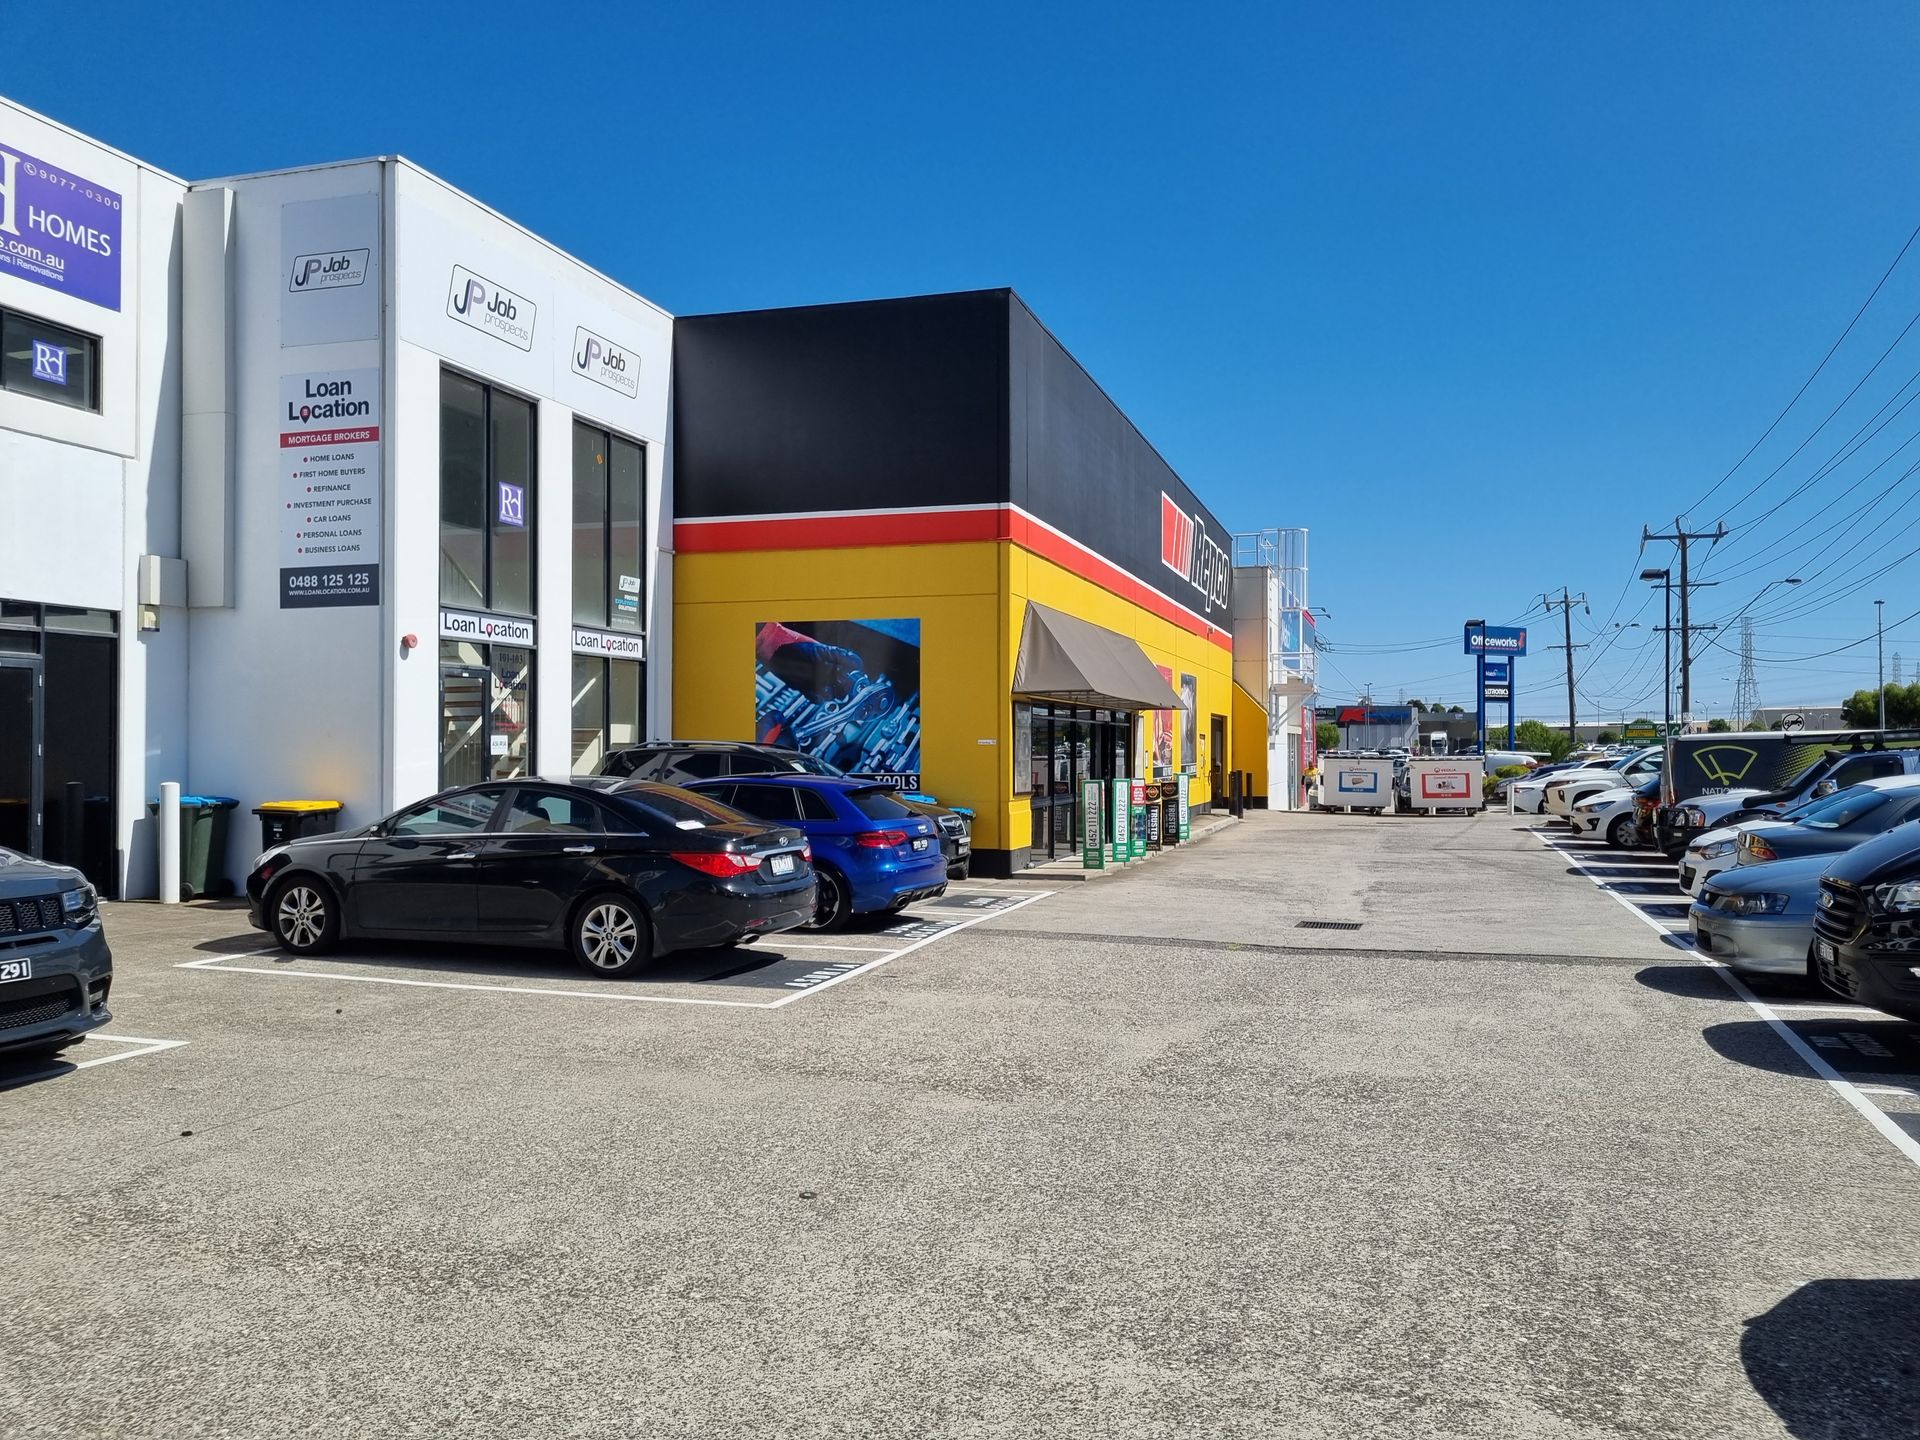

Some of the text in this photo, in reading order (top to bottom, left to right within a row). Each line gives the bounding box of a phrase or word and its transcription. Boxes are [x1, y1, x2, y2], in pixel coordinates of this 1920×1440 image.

[39, 169, 120, 210] 9077-0300
[28, 205, 112, 257] HOMES
[17, 258, 64, 282] Renovations
[323, 256, 351, 273] Job
[320, 270, 362, 285] prospects
[487, 292, 517, 321] Job
[484, 311, 529, 341] prospects
[602, 348, 626, 372] Job
[600, 366, 635, 390] prospects
[305, 379, 352, 398] Loan
[288, 431, 370, 445] MORTGAGE BROKERS
[310, 453, 355, 462] HOME LOANS
[299, 467, 366, 478] FIRST HOME BUYERS
[313, 483, 351, 493] REFINANCE
[293, 498, 372, 509] INVESTMENT PURCHASE
[313, 514, 352, 523] CAR LOANS
[303, 529, 362, 539] PERSONAL LOANS
[304, 544, 361, 554] BUSINESS LOANS
[289, 573, 369, 588] 0488 125 125
[288, 587, 370, 596] WWW.LOANLOCATION.COM.AU
[444, 613, 476, 634] Loan
[575, 631, 599, 649] Loan
[1471, 635, 1518, 648] Offceworks
[1088, 801, 1097, 815] 222
[1118, 799, 1126, 812] 222
[1088, 816, 1097, 827] 111
[1118, 812, 1126, 823] 111
[1168, 803, 1176, 834] TRUSTED
[1088, 828, 1098, 847] 0452
[1118, 824, 1126, 842] 0452
[1, 962, 27, 980] 291
